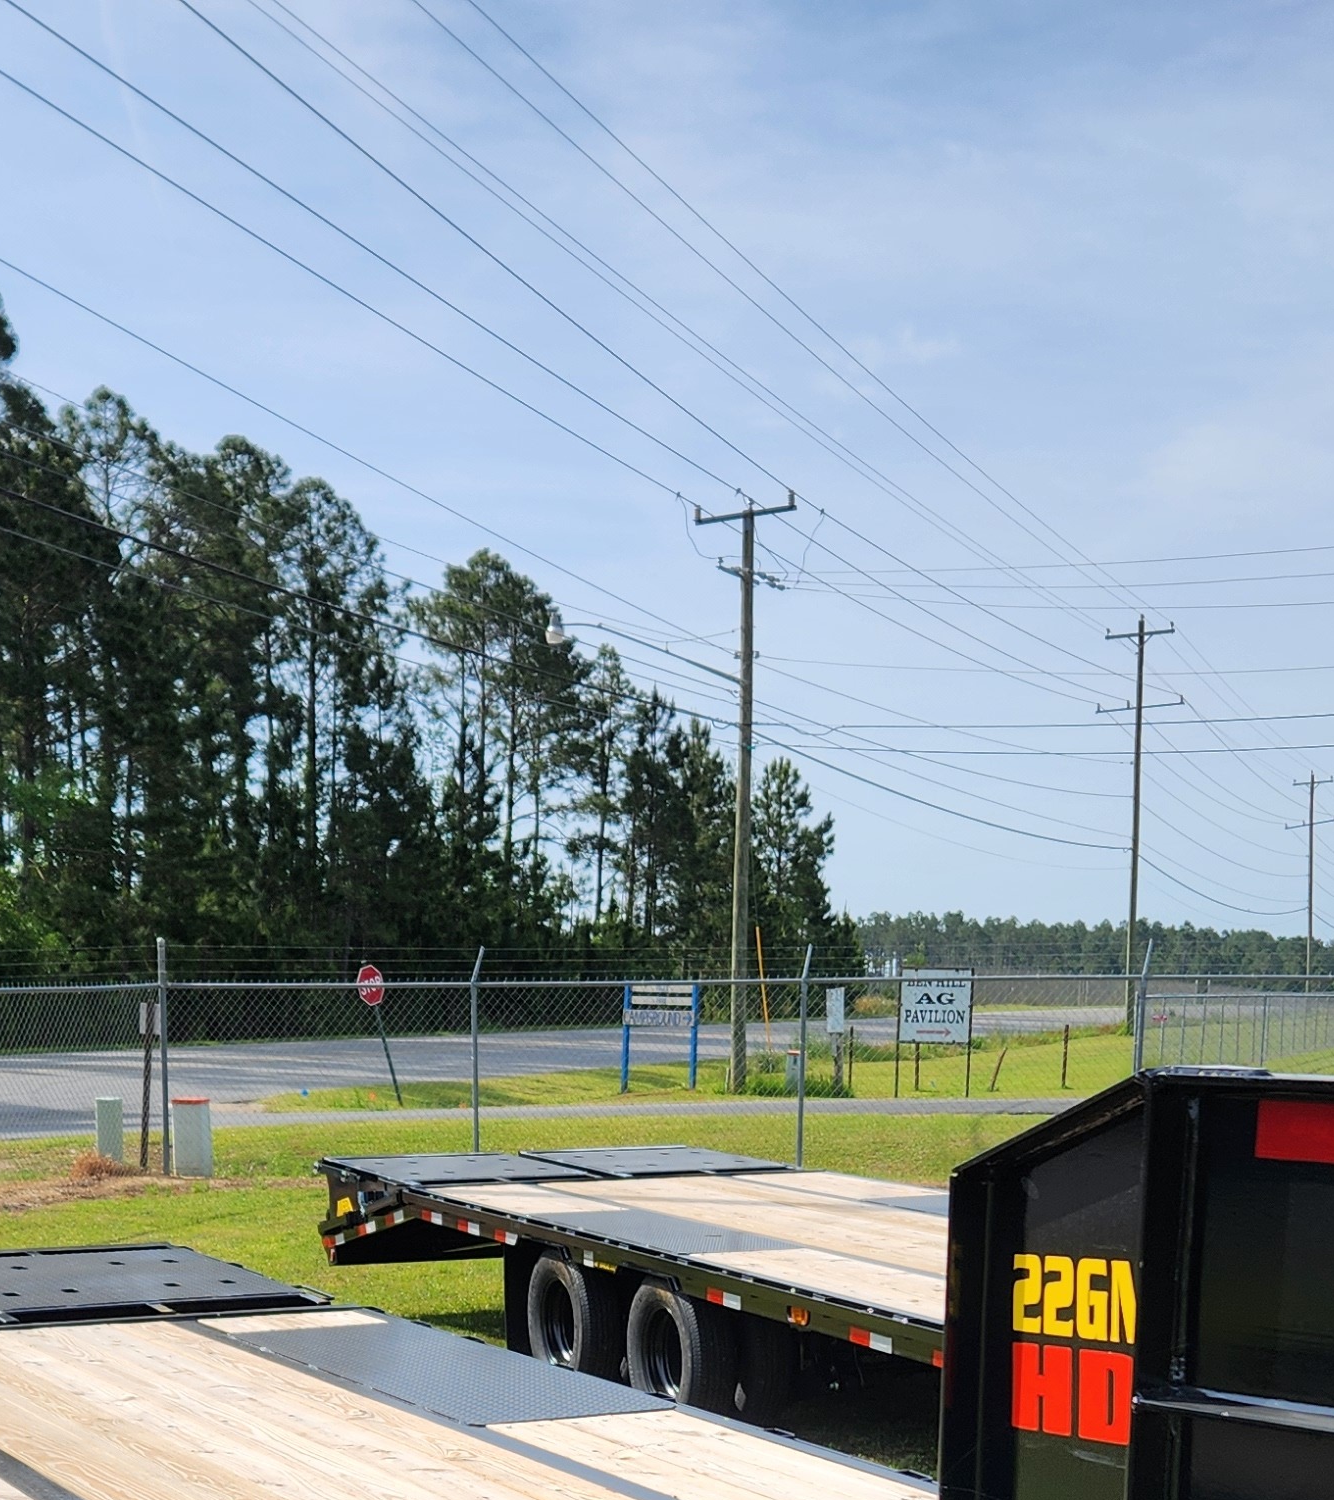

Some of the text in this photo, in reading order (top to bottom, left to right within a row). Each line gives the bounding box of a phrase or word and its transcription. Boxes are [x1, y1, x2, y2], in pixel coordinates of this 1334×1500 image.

[360, 976, 381, 995] STOP
[915, 992, 956, 1006] AG
[904, 1009, 966, 1024] PAVILION
[1011, 1341, 1134, 1446] HD
